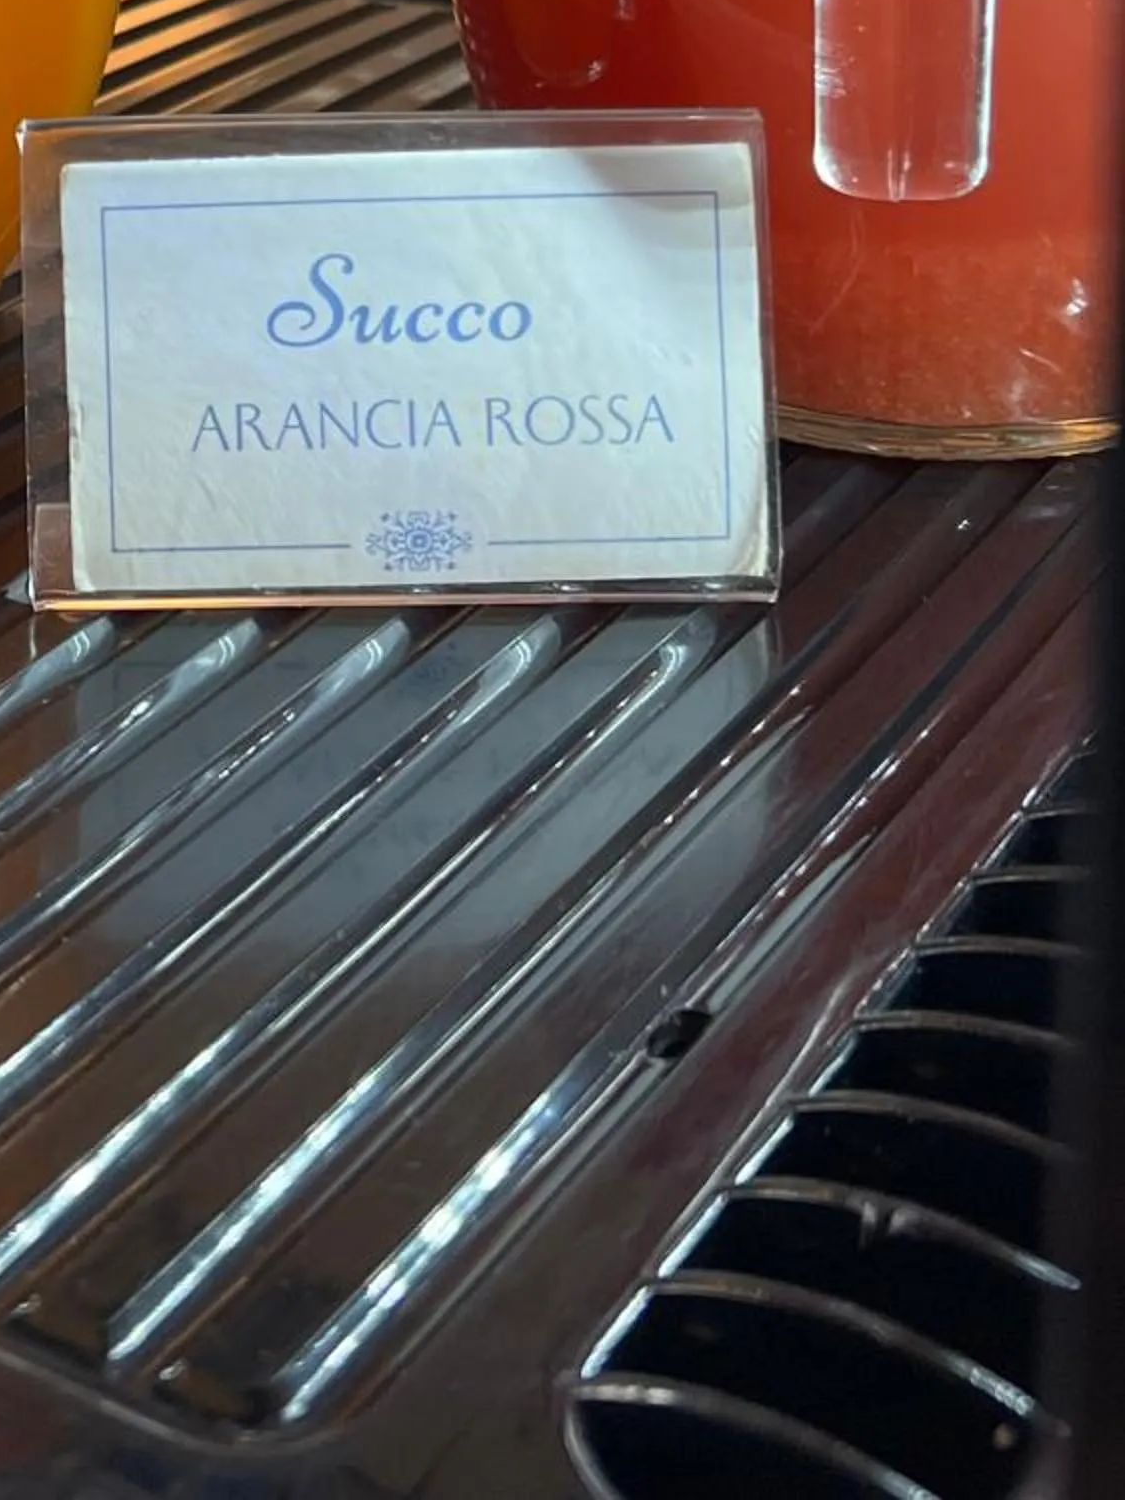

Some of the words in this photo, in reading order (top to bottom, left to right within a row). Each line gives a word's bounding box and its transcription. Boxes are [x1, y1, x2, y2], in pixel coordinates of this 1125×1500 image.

[266, 253, 533, 347] Succo
[191, 397, 462, 452] ARANCIA
[484, 394, 676, 449] ROSSA
